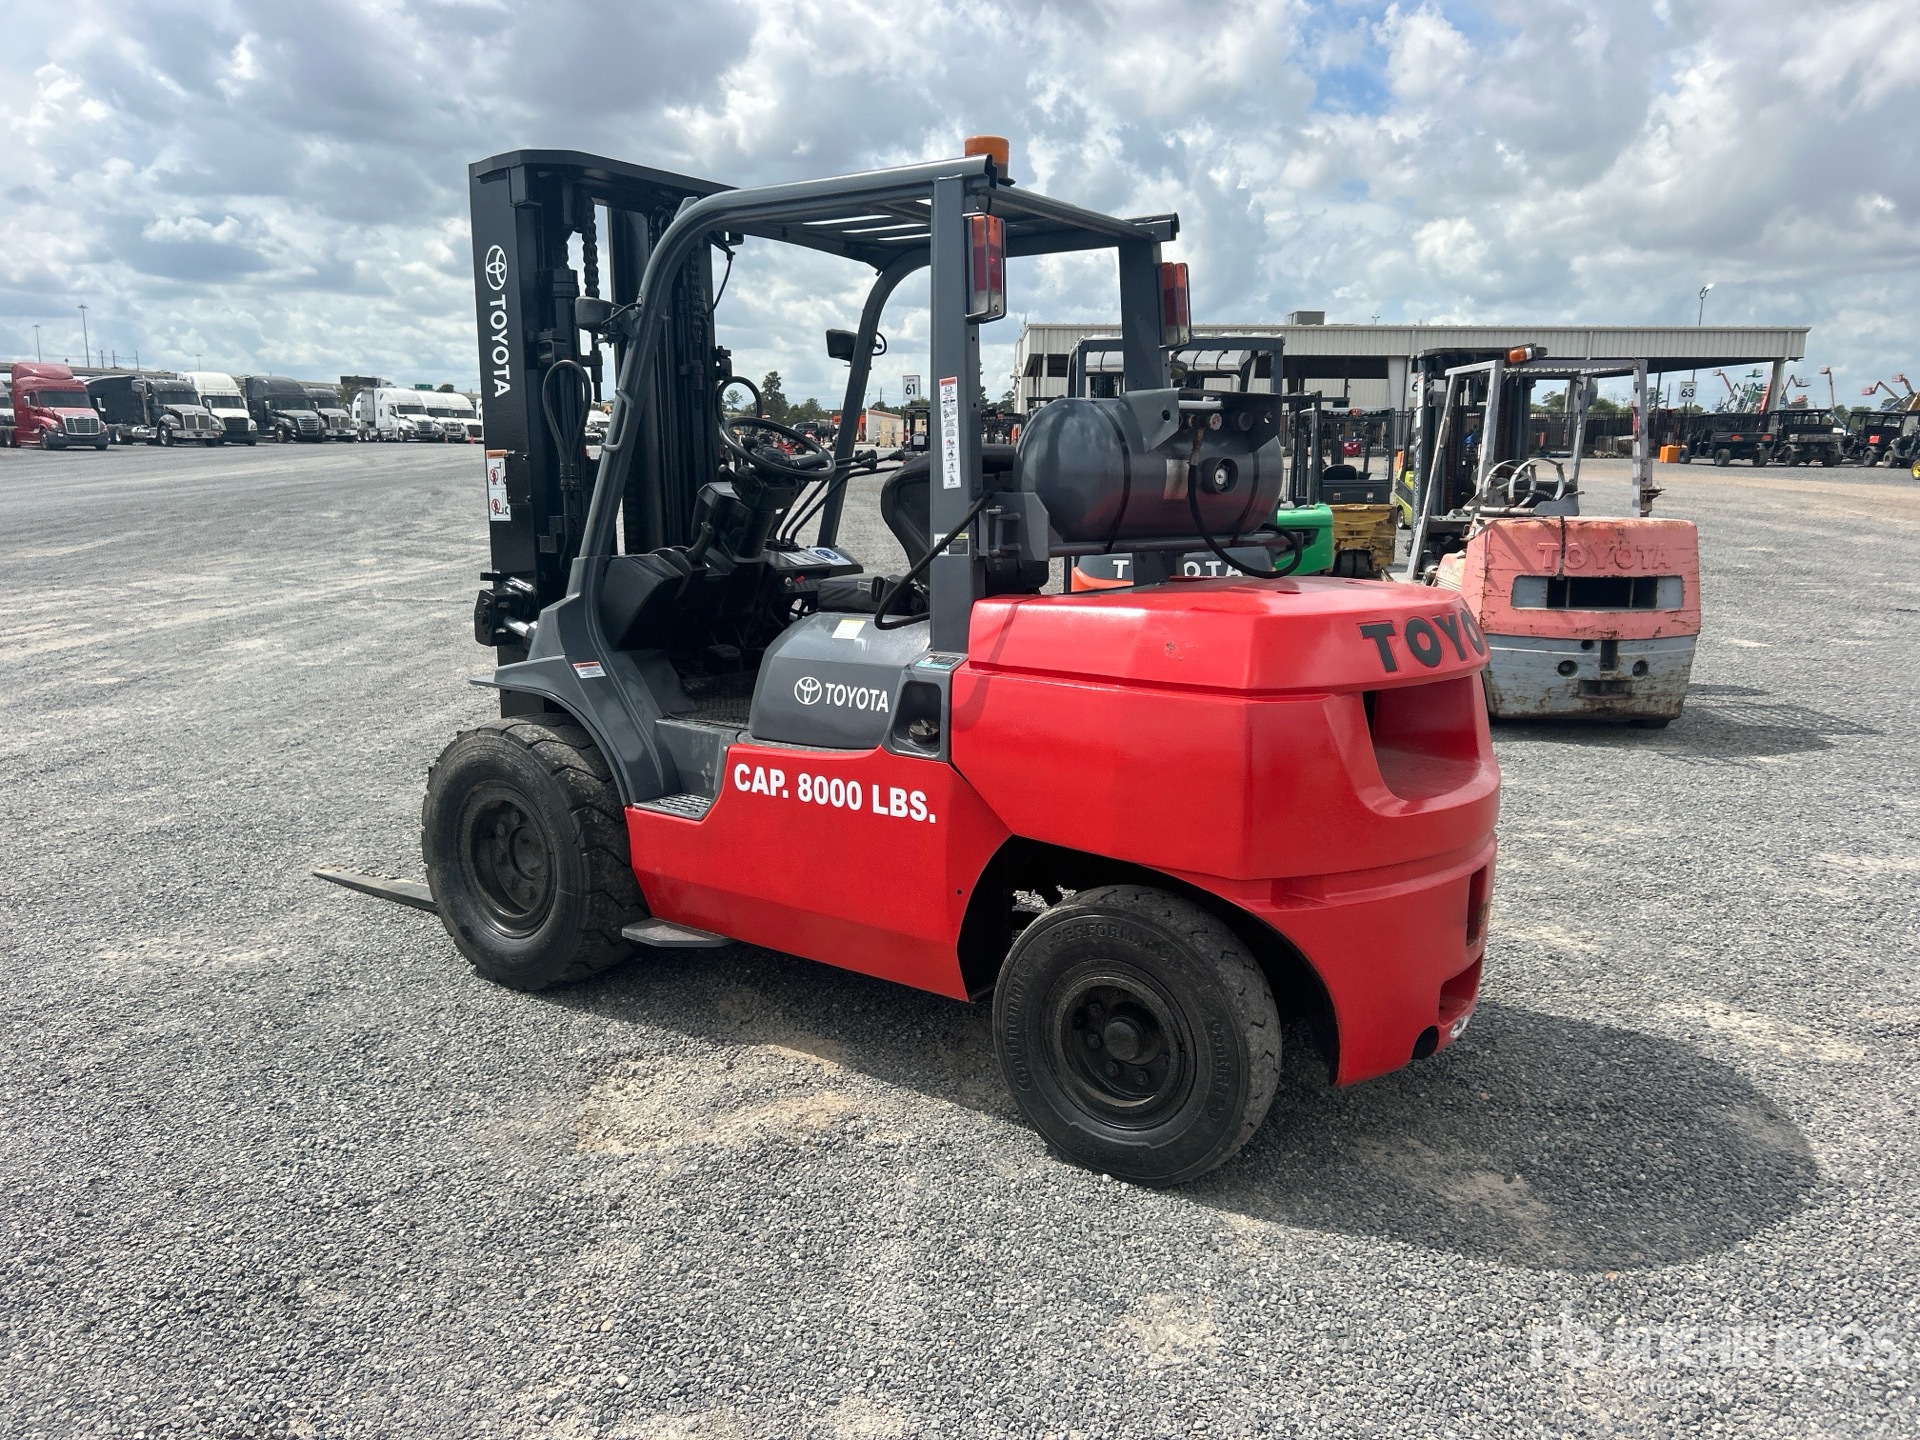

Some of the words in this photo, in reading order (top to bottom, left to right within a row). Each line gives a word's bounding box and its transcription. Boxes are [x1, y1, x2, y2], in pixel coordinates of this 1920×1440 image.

[489, 294, 511, 398] TOYOTA
[905, 383, 916, 395] 61
[1680, 388, 1695, 398] 63
[1112, 559, 1244, 579] TOTA
[825, 683, 889, 713] TOYOTA
[734, 763, 789, 799] CAP.
[797, 773, 862, 811] 8000
[872, 785, 936, 824] LBS.
